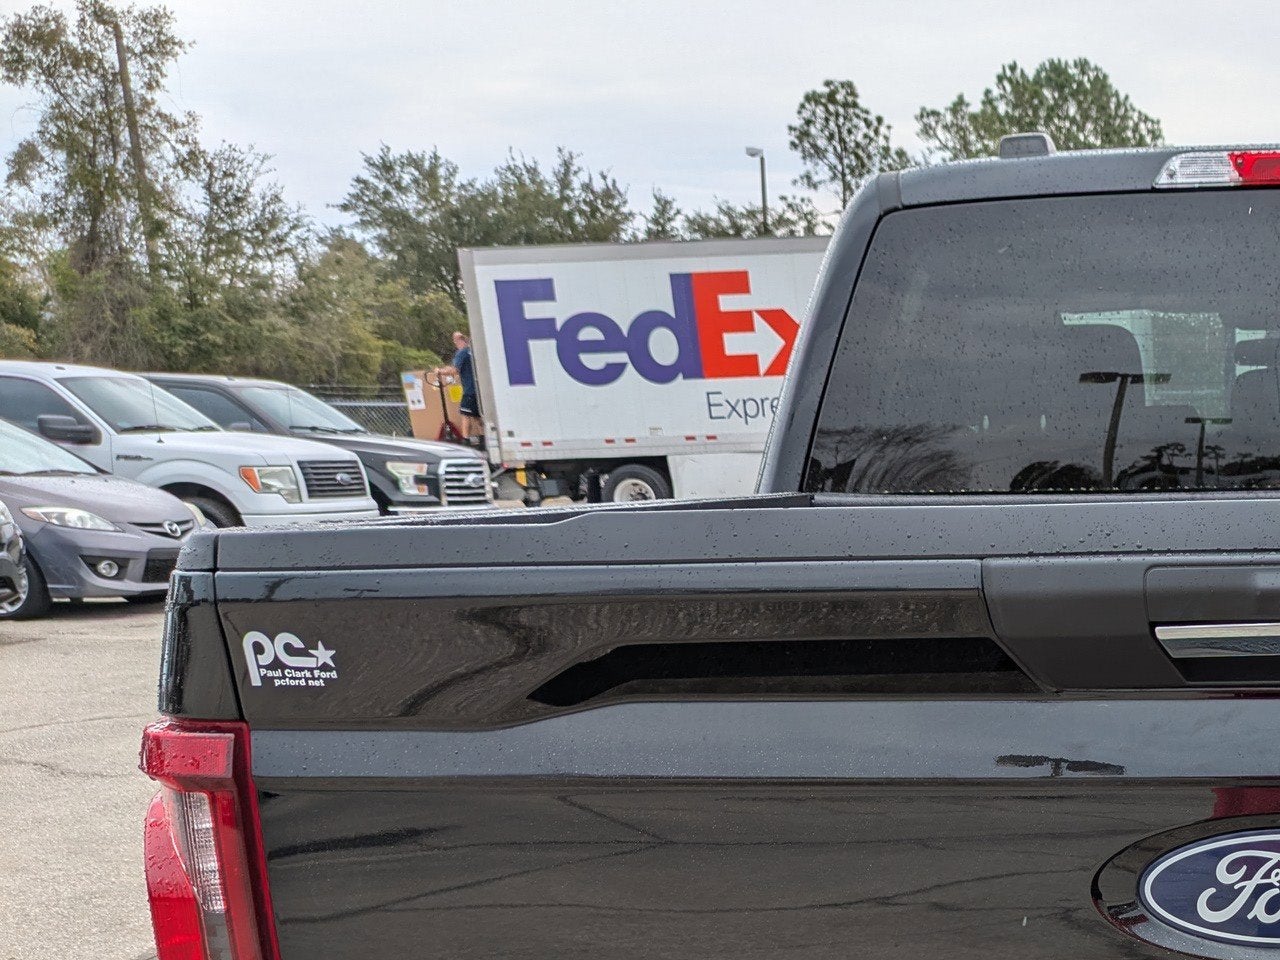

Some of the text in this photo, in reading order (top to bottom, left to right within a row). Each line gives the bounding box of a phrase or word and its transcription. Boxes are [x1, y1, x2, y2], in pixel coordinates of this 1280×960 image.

[259, 668, 337, 678] Paul Clark Ford
